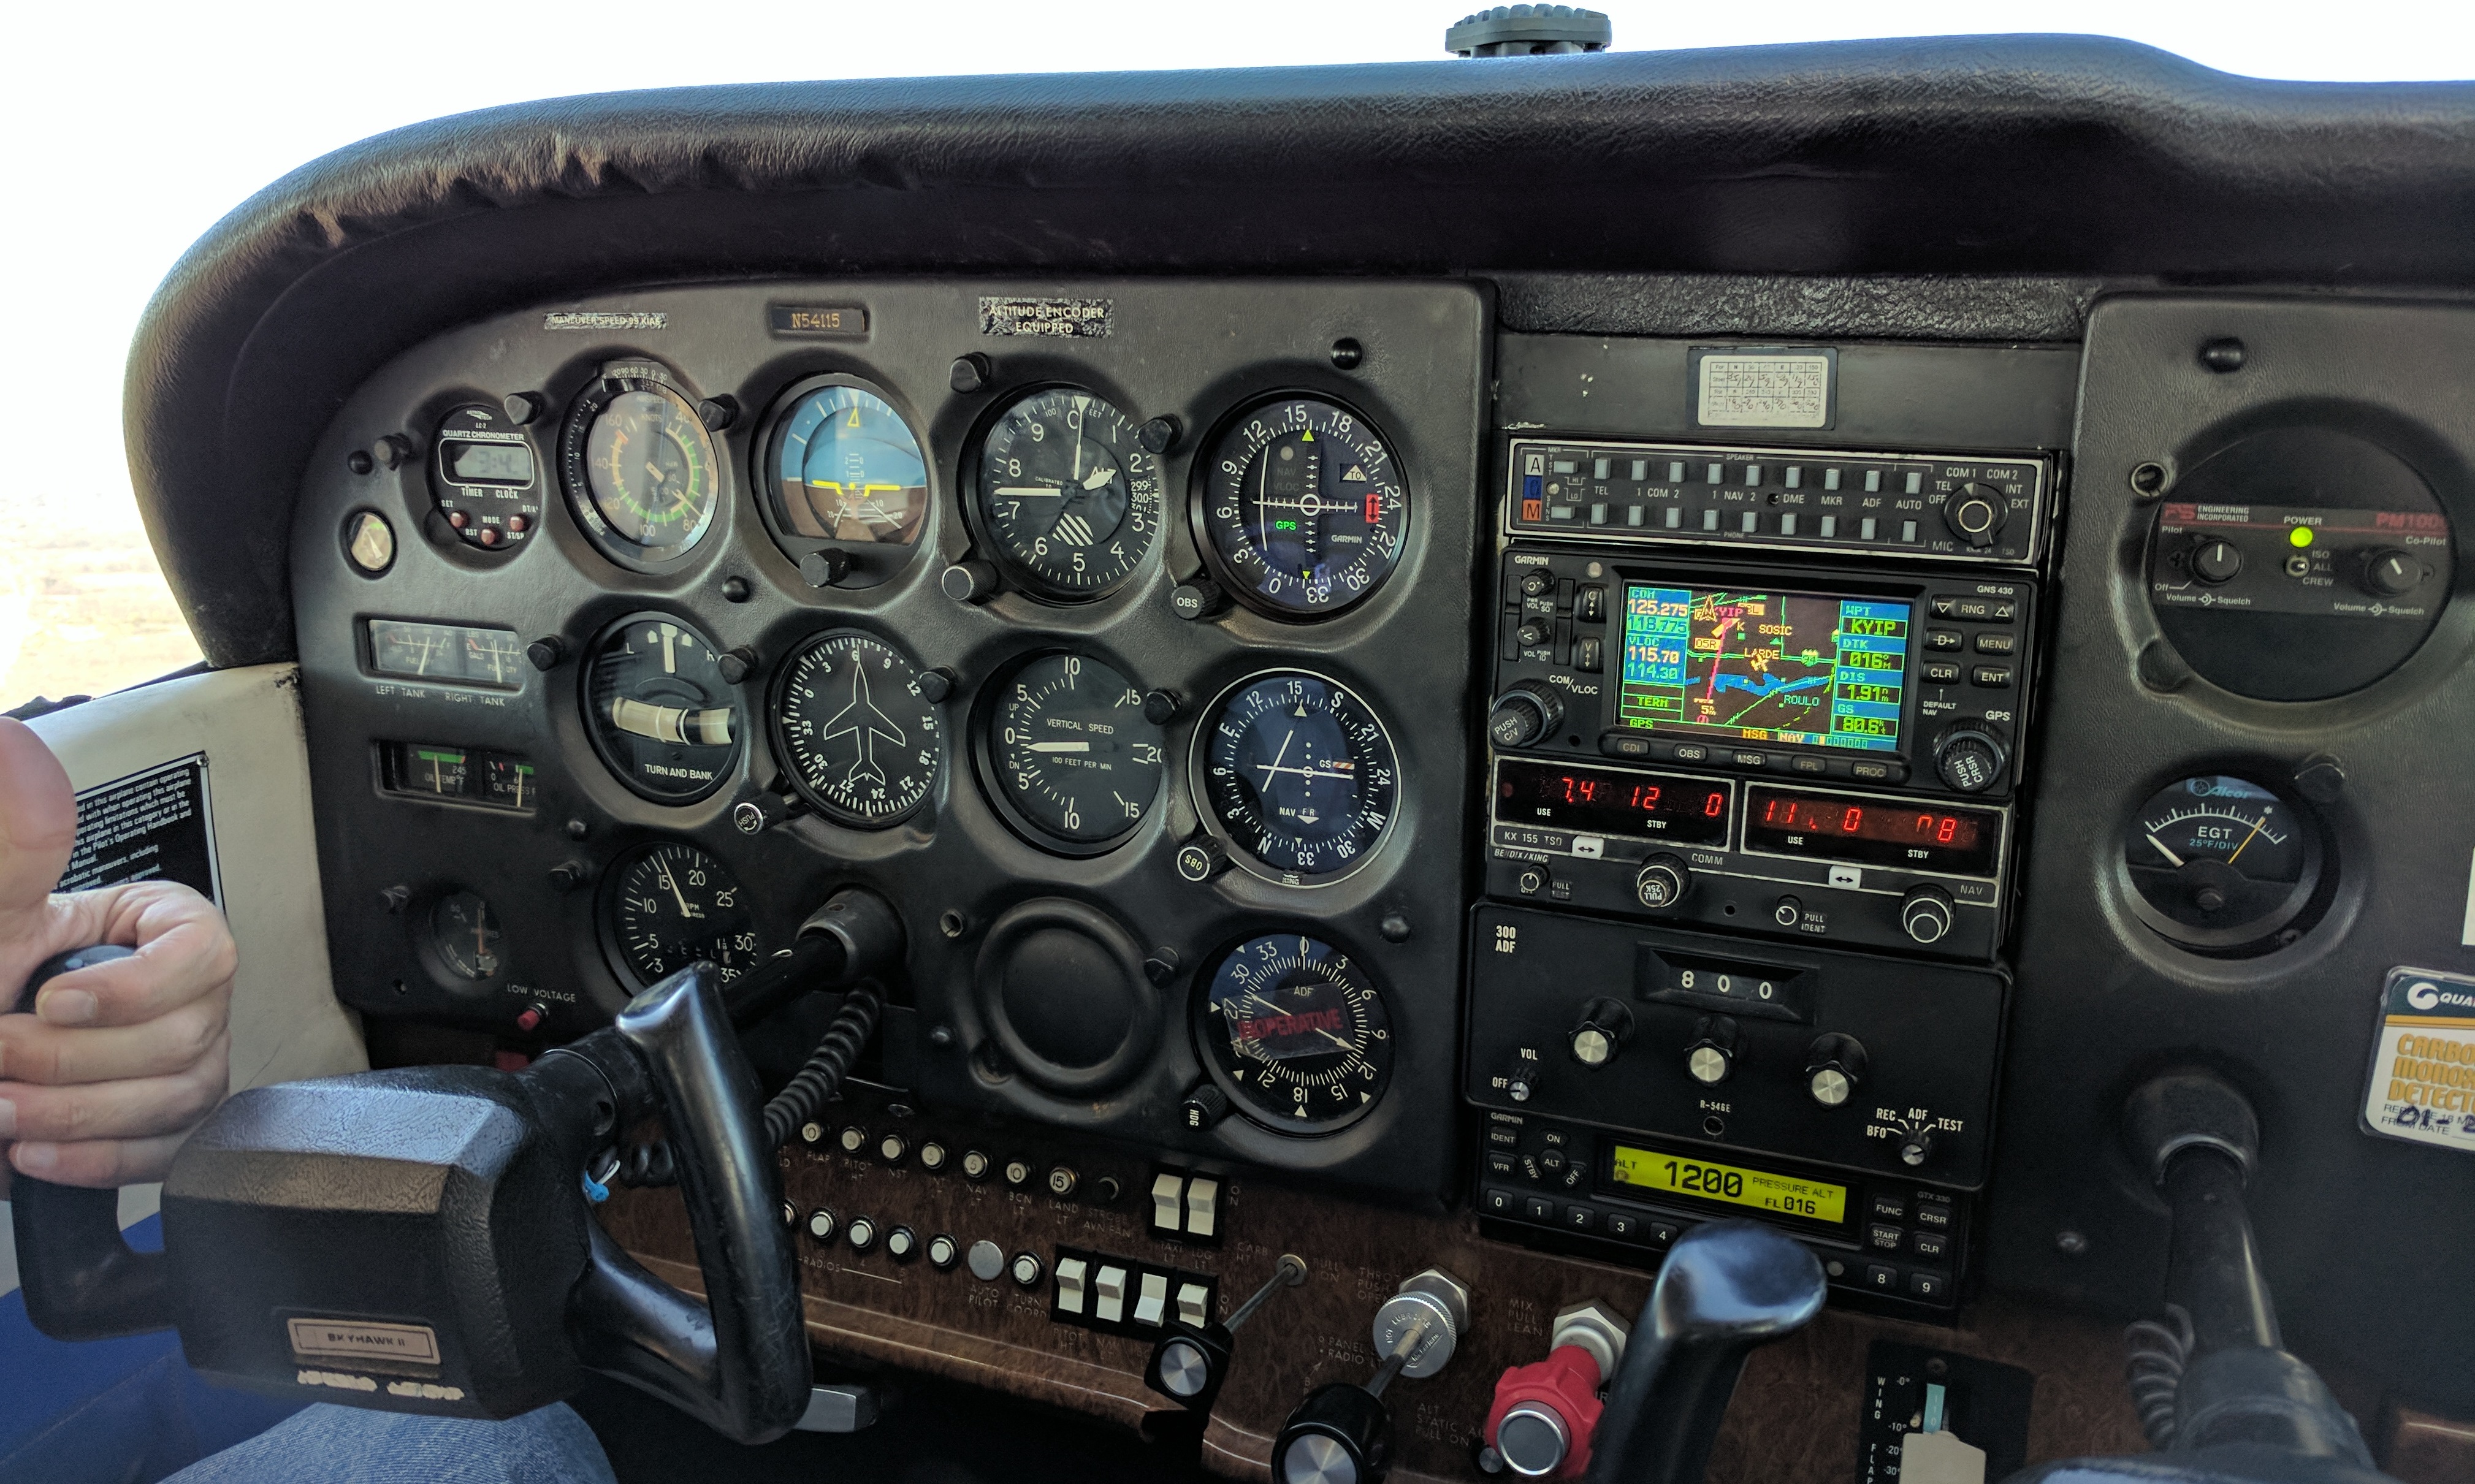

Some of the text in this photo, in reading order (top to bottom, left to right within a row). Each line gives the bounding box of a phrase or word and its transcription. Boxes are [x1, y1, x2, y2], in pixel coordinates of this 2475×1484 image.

[989, 306, 1104, 319] ALTITUDE ENCODER
[791, 313, 840, 329] N54115
[1016, 322, 1074, 333] EQUIPPED
[471, 431, 524, 440] CHRONOMETER
[1946, 467, 1970, 478] COM
[1986, 468, 2010, 479] COM
[1595, 486, 1609, 495] TEL
[1935, 481, 1951, 490] TEL
[2005, 484, 2023, 493] INT
[462, 488, 482, 497] TIMER
[496, 490, 518, 499] CLOCK
[1647, 489, 1668, 498] COM
[1725, 492, 1743, 500] NAV
[1783, 494, 1804, 504] DME
[1821, 496, 1842, 506] MKR
[1862, 498, 1881, 508] ADF
[1929, 495, 1946, 504] OFF
[2011, 499, 2029, 509] EXT
[1896, 500, 1922, 510] AUTO
[2198, 505, 2249, 515] ENGINEERING
[2197, 513, 2249, 522] INCORPORATED
[2284, 516, 2322, 525] POWER
[1276, 521, 1296, 531] GPS
[2162, 525, 2183, 535] Pilot
[1331, 535, 1362, 544] GARMIN
[2405, 536, 2446, 546] Co-Pilot
[1932, 541, 1953, 551] MIC
[1514, 555, 1549, 565] GARMIN
[2312, 550, 2330, 559] ISO
[2302, 576, 2333, 586] CREW
[1631, 589, 1655, 598] COM
[1977, 585, 1996, 594] GNS
[1176, 598, 1198, 607] OBS
[2166, 593, 2251, 606] Volume Squelch
[1629, 599, 1688, 617] 125.275
[1845, 605, 1871, 617] WPT
[1961, 604, 1985, 614] RNG
[2333, 603, 2424, 615] Volume Squelch
[1628, 617, 1686, 633] 118.775
[1758, 624, 1793, 636] SOSIC
[1851, 618, 1897, 636] KYIP
[1629, 636, 1660, 647] VLOC
[1843, 638, 1868, 650] DTK
[1979, 639, 2010, 649] MENU
[1628, 646, 1679, 663] 115.70
[1628, 663, 1678, 680] 114.30
[1840, 671, 1866, 682] DIS
[1930, 668, 1952, 678] CLR
[1981, 672, 2004, 683] ENT
[376, 686, 425, 698] LEFT TANK
[445, 692, 505, 706] RIGHT TANK
[1637, 696, 1668, 707] TERM
[1783, 694, 1820, 706] ROULO
[1837, 704, 1854, 714] GS
[1923, 701, 1956, 710] DEFAULT
[1985, 710, 2010, 721] GPS
[1047, 718, 1114, 734] VERTICAL SPEED
[1494, 717, 1517, 735] PUSH
[1630, 719, 1653, 729] GPS
[1742, 729, 1768, 740] MSG
[1779, 732, 1805, 744] NAV
[1623, 742, 1640, 753] CDI
[1679, 748, 1700, 759] OBS
[1065, 757, 1081, 766] FEET
[1084, 759, 1097, 769] PER
[1737, 754, 1761, 765] MSG
[1800, 761, 1818, 771] FPL
[644, 764, 713, 780] TURN AND BANK
[1856, 766, 1885, 778] PROC
[1537, 807, 1551, 816] USE
[1647, 820, 1666, 829] STBY
[1504, 831, 1538, 844] KX 155
[2197, 826, 2232, 840] EGT
[1788, 835, 1803, 845] USE
[1691, 853, 1723, 866] COMM
[1907, 849, 1929, 859] STBY
[1184, 854, 1203, 871] OBS
[1960, 885, 1983, 896] NAV
[1804, 913, 1824, 923] PULL
[1496, 925, 1516, 939] 300
[1801, 923, 1825, 933] IDENT
[1495, 939, 1516, 953] ADF
[507, 983, 576, 1002] LOW VOLTAGE
[1294, 986, 1313, 997] ADF
[1521, 1048, 1538, 1060] VOL
[1492, 1077, 1508, 1089] OFF
[1189, 1109, 1199, 1127] HDG
[1490, 1113, 1523, 1124] GARMIN
[1876, 1108, 1896, 1121] REC
[1908, 1108, 1928, 1121] ADF
[1937, 1117, 1963, 1132] TEST
[1866, 1125, 1886, 1138] BFO
[1491, 1133, 1514, 1143] IDENT
[1547, 1134, 1560, 1143] ON
[1493, 1162, 1509, 1171] VFR
[1544, 1159, 1560, 1167] ALT
[1615, 1158, 1637, 1170] ALT
[1664, 1161, 1742, 1197] 1200
[1753, 1176, 1808, 1195] PRESSURE
[1918, 1191, 1951, 1203] GTX 330
[1049, 1200, 1079, 1214] LAND
[1765, 1197, 1815, 1214] FL 016
[1877, 1204, 1902, 1216] FUNC
[1920, 1212, 1947, 1225] CRSR
[1874, 1230, 1899, 1241] START
[1237, 1242, 1268, 1256] CARB
[1874, 1239, 1896, 1249] STOP
[1920, 1243, 1939, 1254] CLR
[1015, 1294, 1041, 1306] TURN
[1509, 1298, 1533, 1311] MIX
[1328, 1349, 1365, 1364] RADIO
[1417, 1414, 1457, 1432] STATIC
